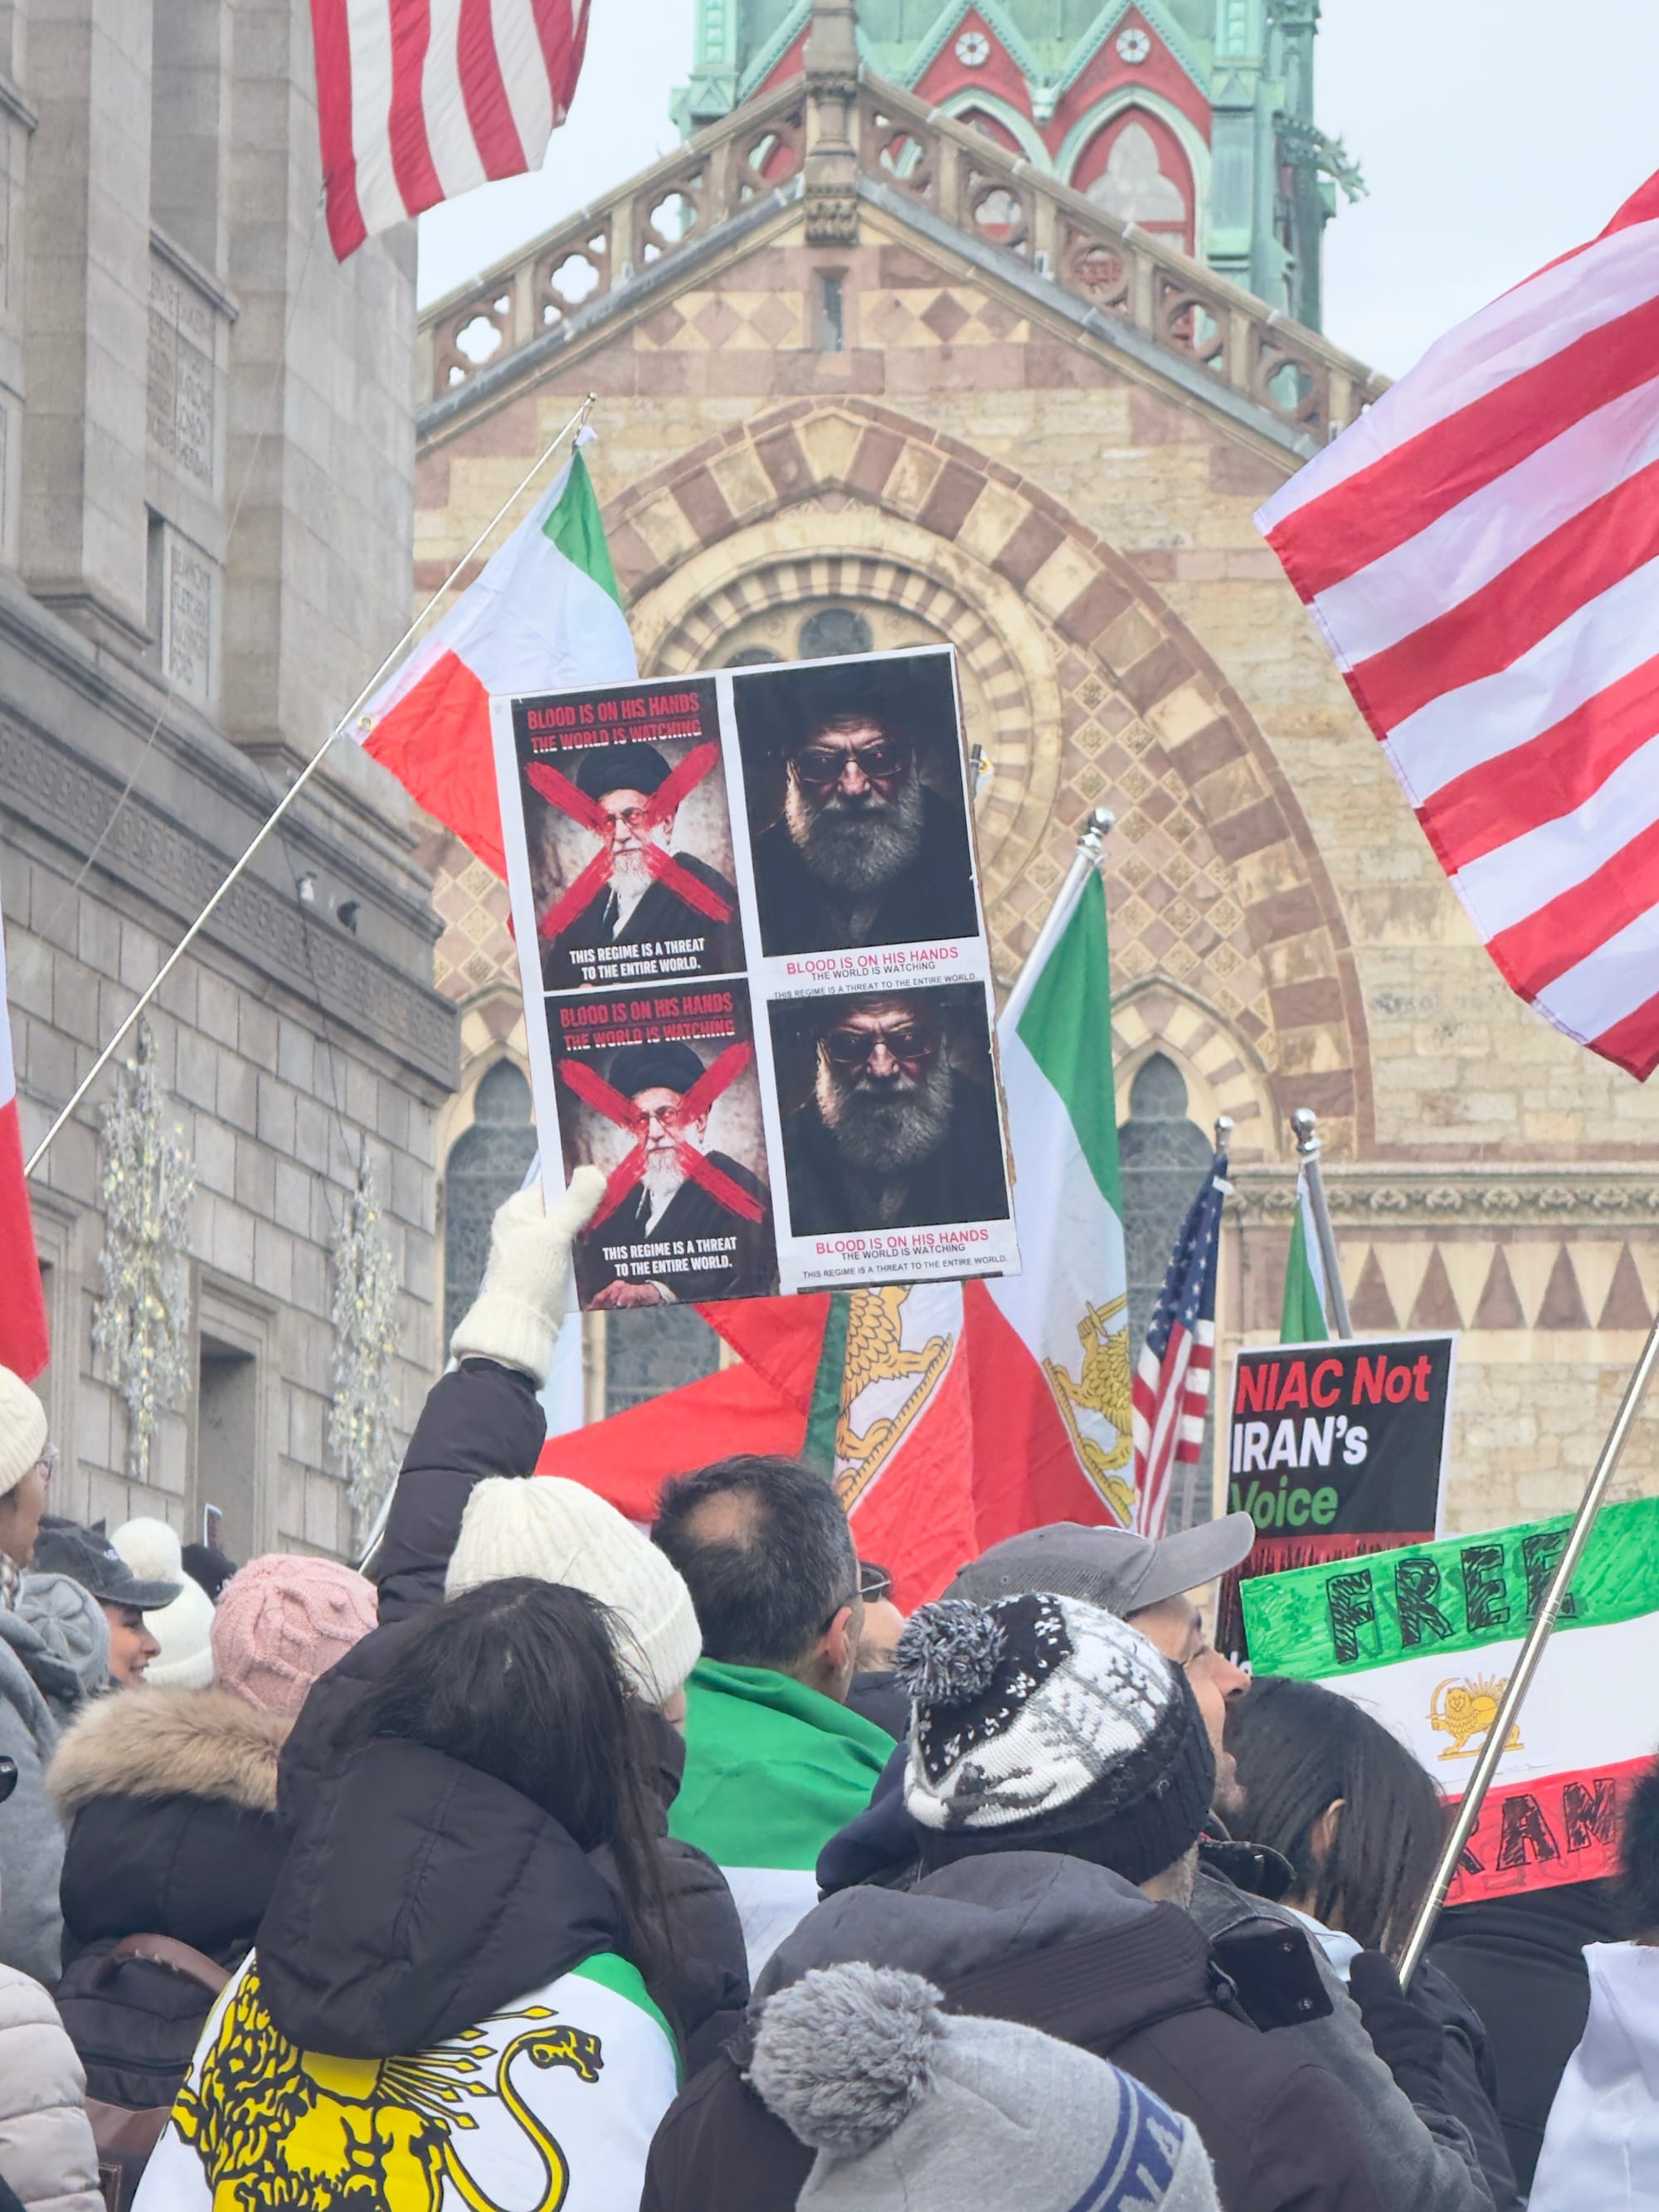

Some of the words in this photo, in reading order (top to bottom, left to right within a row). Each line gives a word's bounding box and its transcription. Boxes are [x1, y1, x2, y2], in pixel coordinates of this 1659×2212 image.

[528, 706, 576, 730] BLOOD
[579, 703, 595, 724] IS
[597, 701, 618, 722] ON
[621, 698, 646, 719] HIS
[648, 692, 700, 717] HANDS
[531, 735, 557, 754] THE
[559, 729, 610, 750] WORLD
[613, 727, 627, 745] IS
[630, 719, 702, 743] WATCHING
[569, 949, 596, 965] THIS
[596, 944, 640, 961] REGIME
[641, 942, 653, 957] IS
[654, 941, 664, 956] A
[664, 937, 705, 954] THREAT
[786, 959, 836, 975] BLOOD
[840, 956, 853, 970] IS
[858, 955, 878, 968] ON
[883, 951, 906, 965] HIS
[910, 946, 959, 962] HANDS
[581, 966, 596, 981] TO
[597, 963, 619, 979] THE
[620, 960, 658, 977] ENTIRE
[659, 956, 701, 973] WORLD.
[811, 972, 830, 981] THE
[833, 967, 868, 979] WORLD
[872, 966, 881, 975] IS
[883, 961, 936, 975] WATCHING
[774, 990, 792, 999] THIS
[795, 987, 825, 997] REGIME
[846, 982, 879, 992] THREAT
[882, 980, 893, 989] TO
[896, 979, 911, 987] THE
[912, 975, 942, 985] ENTIRE
[560, 1004, 608, 1028] BLOOD
[612, 1002, 628, 1023] IS
[630, 1000, 652, 1020] ON
[654, 998, 679, 1018] HIS
[682, 992, 733, 1015] HANDS
[564, 1033, 591, 1052] THE
[593, 1028, 643, 1048] WORLD
[646, 1026, 660, 1043] IS
[663, 1019, 736, 1042] WATCHING
[602, 1246, 628, 1261] THIS
[630, 1242, 671, 1258] REGIME
[674, 1241, 685, 1255] IS
[687, 1240, 695, 1254] A
[696, 1237, 737, 1252] THREAT
[816, 1239, 866, 1255] BLOOD
[870, 1237, 883, 1250] IS
[887, 1236, 907, 1248] ON
[912, 1233, 935, 1247] HIS
[939, 1228, 989, 1244] HANDS
[842, 1252, 860, 1261] THE
[863, 1249, 898, 1259] WORLD
[901, 1247, 910, 1256] IS
[912, 1243, 966, 1255] WATCHING
[615, 1263, 629, 1277] TO
[630, 1261, 650, 1276] THE
[653, 1257, 689, 1274] ENTIRE
[691, 1255, 732, 1271] WORLD.
[803, 1271, 821, 1279] THIS
[824, 1267, 855, 1277] REGIME
[877, 1263, 908, 1271] THREAT
[911, 1262, 922, 1270] TO
[925, 1260, 941, 1268] THE
[942, 1257, 971, 1267] ENTIRE
[1236, 1359, 1344, 1413] NIAC
[1351, 1355, 1433, 1405] Not
[1232, 1415, 1368, 1473] IRAN's
[1230, 1475, 1338, 1529] Voice
[1326, 1528, 1579, 1665] FREE
